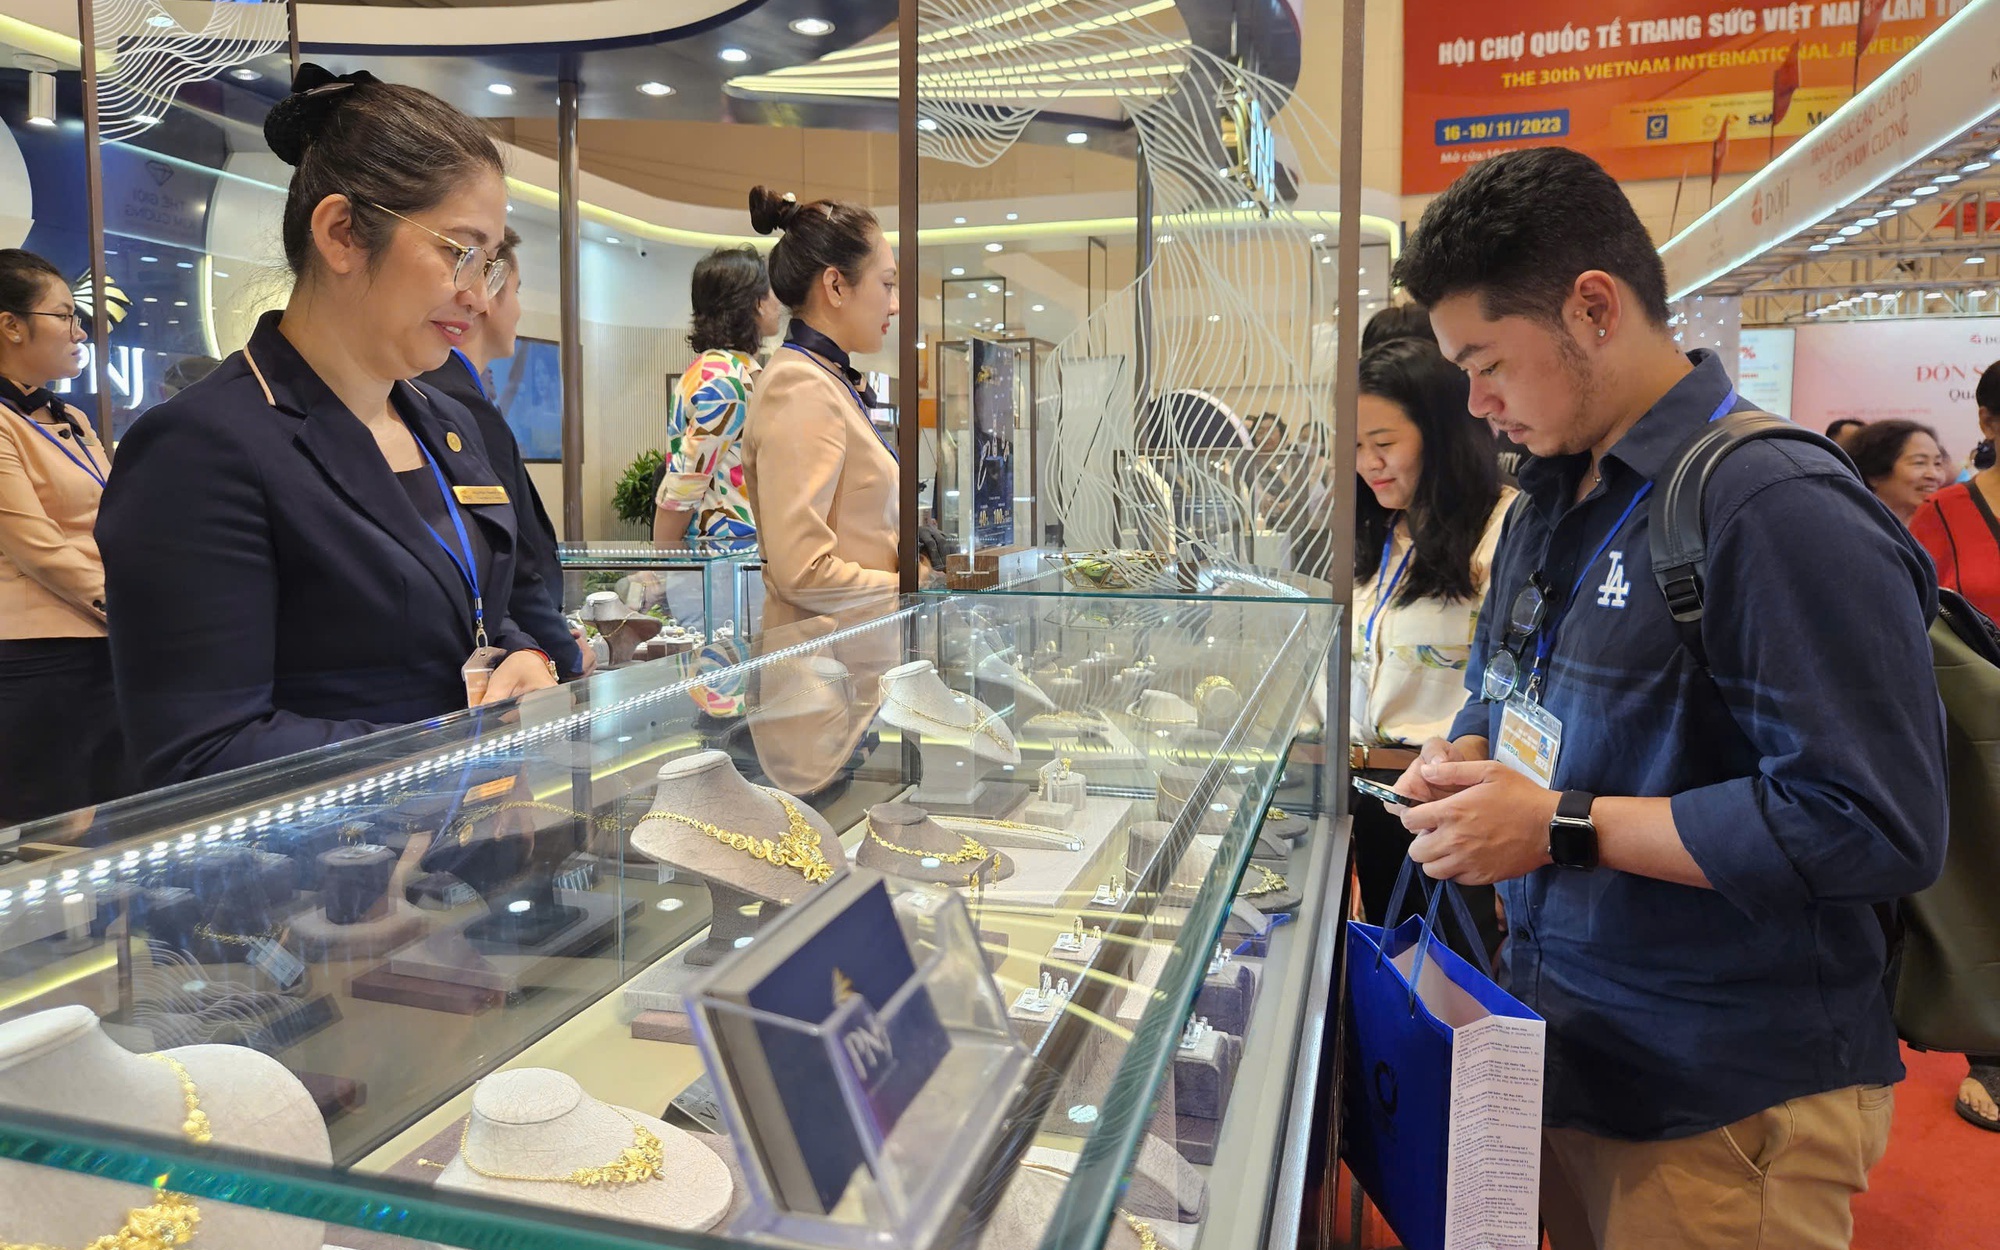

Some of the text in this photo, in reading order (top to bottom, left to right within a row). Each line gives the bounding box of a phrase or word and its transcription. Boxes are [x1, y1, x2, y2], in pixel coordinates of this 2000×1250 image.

[1438, 37, 1475, 67] HỘI
[1480, 31, 1525, 62] CHỢ
[1529, 21, 1590, 58] QUỐC
[1596, 16, 1622, 49] TẾ
[1627, 15, 1701, 46] TRANG
[1708, 7, 1756, 38] SỨC
[1762, 1, 1814, 35] VIỆT
[1502, 70, 1536, 88] THE
[1539, 66, 1581, 86] 30th
[1583, 56, 1671, 81] VIETNAM
[1597, 550, 1631, 608] LA
